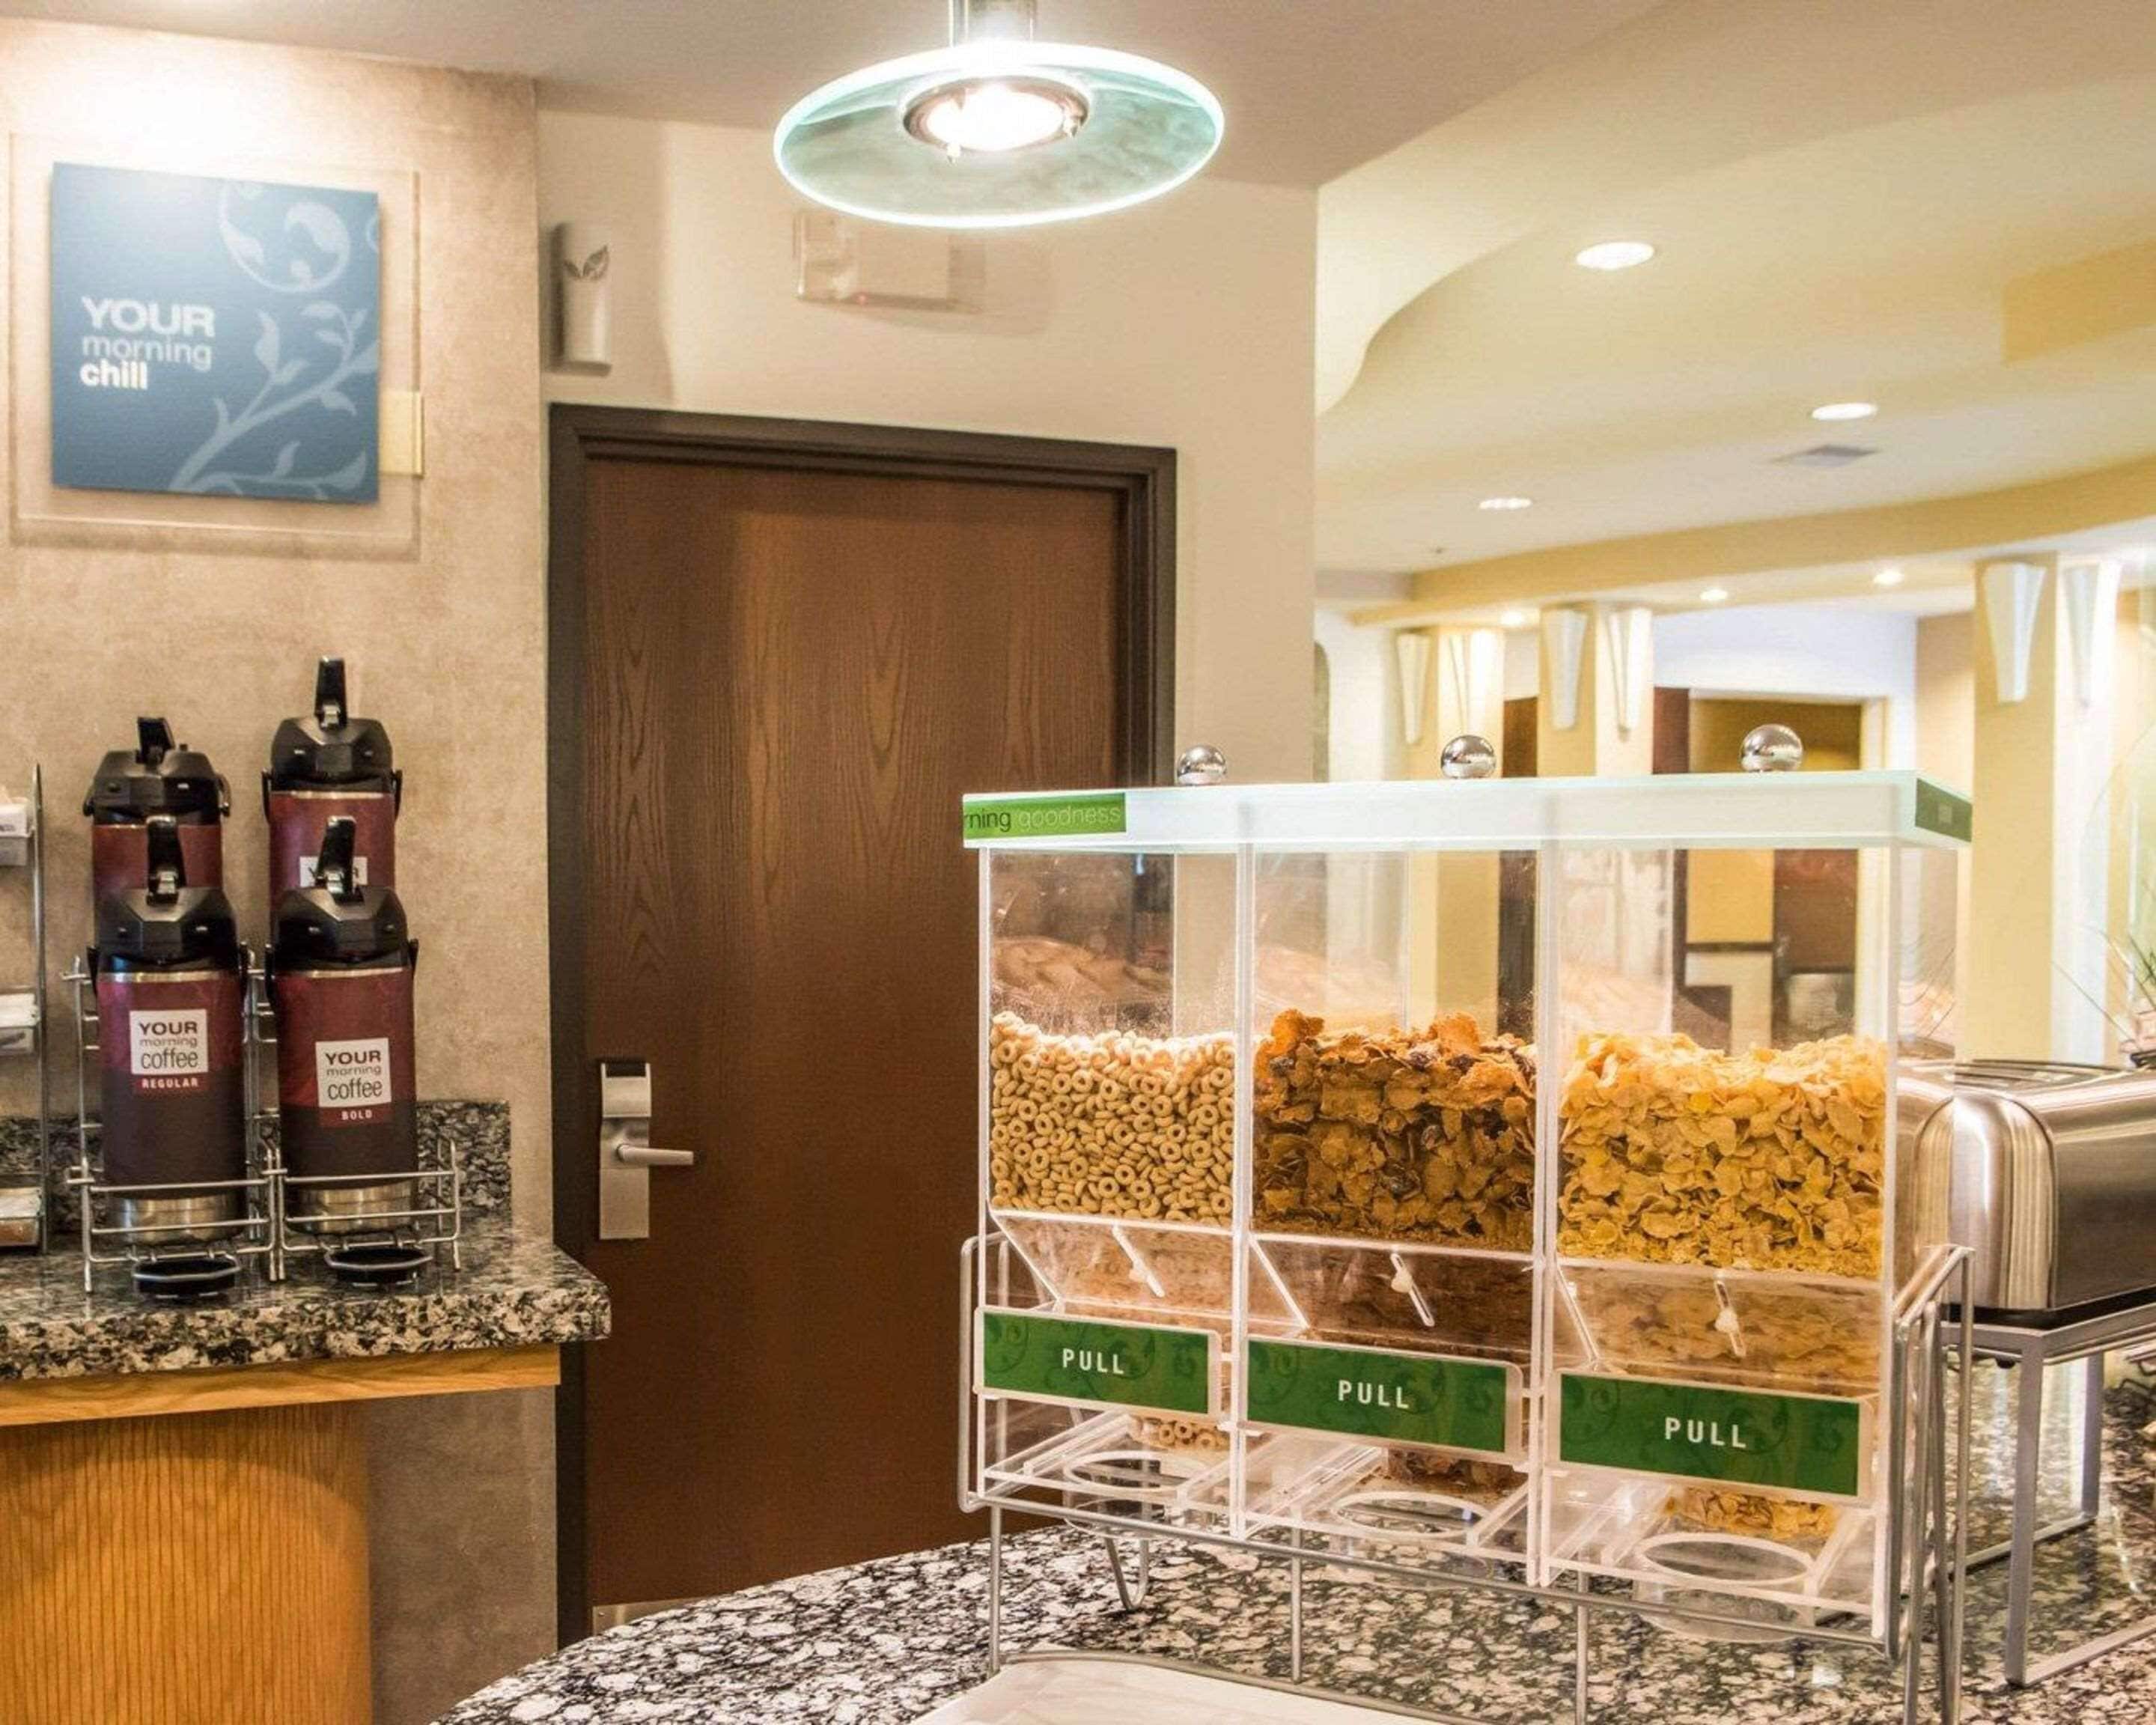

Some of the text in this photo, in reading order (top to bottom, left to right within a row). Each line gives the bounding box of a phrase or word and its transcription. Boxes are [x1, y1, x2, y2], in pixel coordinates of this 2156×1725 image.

[81, 296, 216, 338] YOUR
[83, 336, 212, 371] morning
[79, 358, 147, 389] chill
[1019, 806, 1121, 829] goodness
[139, 1021, 198, 1035] YOUR
[140, 1038, 198, 1048] morning
[141, 1047, 198, 1069] coffee
[325, 1050, 381, 1065] YOUR
[326, 1065, 382, 1076] morning
[141, 1078, 198, 1089] REGULAR
[328, 1078, 383, 1100] coffee
[341, 1110, 373, 1120] BOLD
[1063, 1348, 1124, 1375] PULL
[1338, 1380, 1409, 1408] PULL
[1665, 1417, 1747, 1448] PULL
